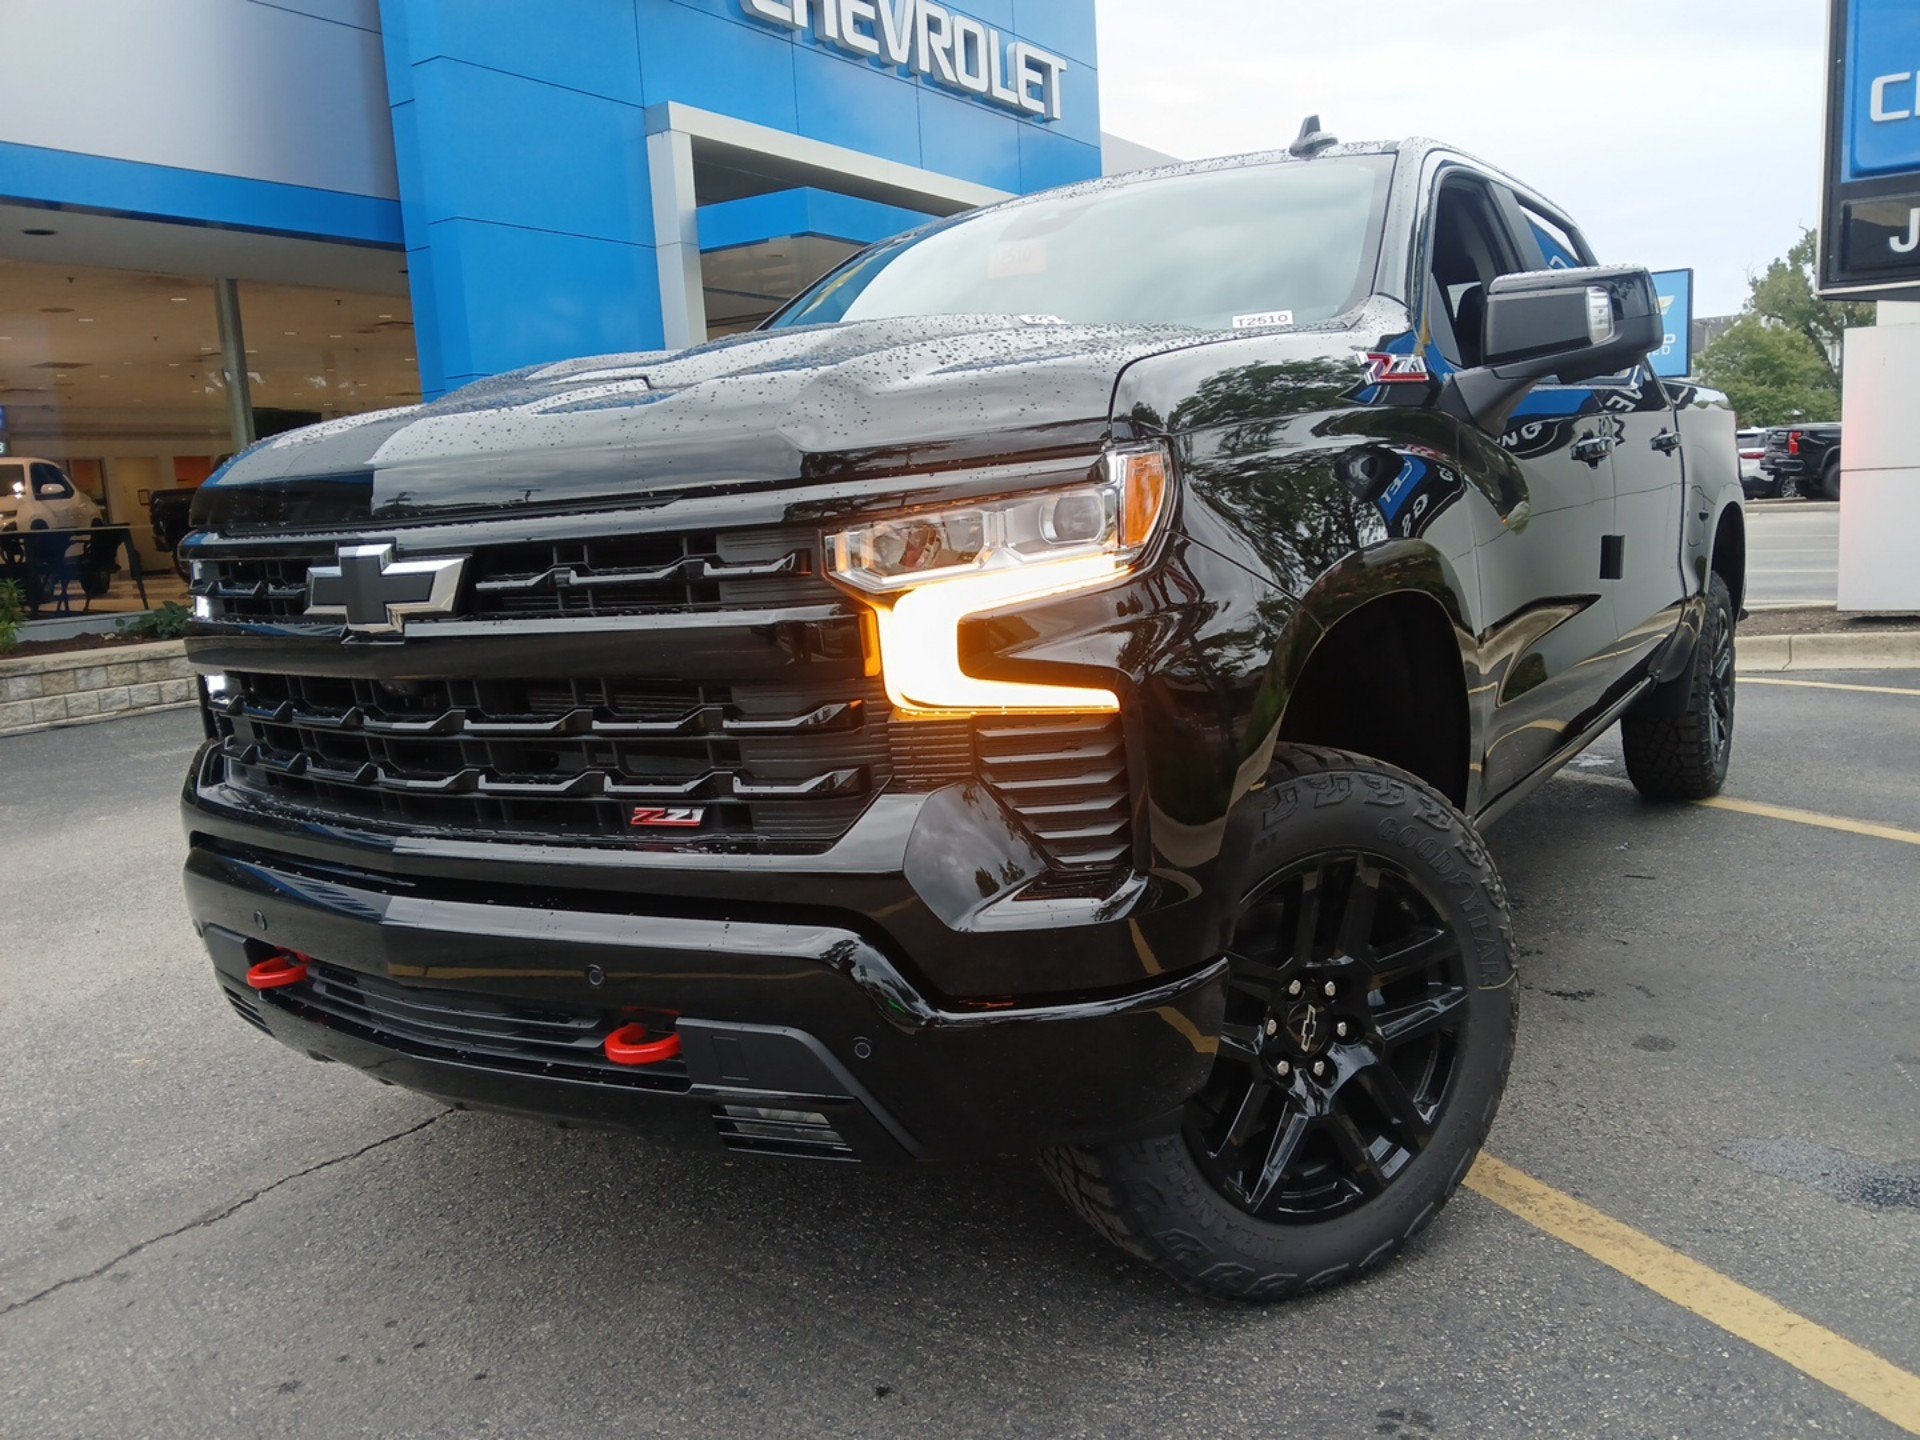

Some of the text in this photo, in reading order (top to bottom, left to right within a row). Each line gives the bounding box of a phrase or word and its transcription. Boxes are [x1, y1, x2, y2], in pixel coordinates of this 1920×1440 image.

[1237, 314, 1289, 327] T2510
[1354, 351, 1430, 385] Z71
[630, 807, 706, 827] Z71
